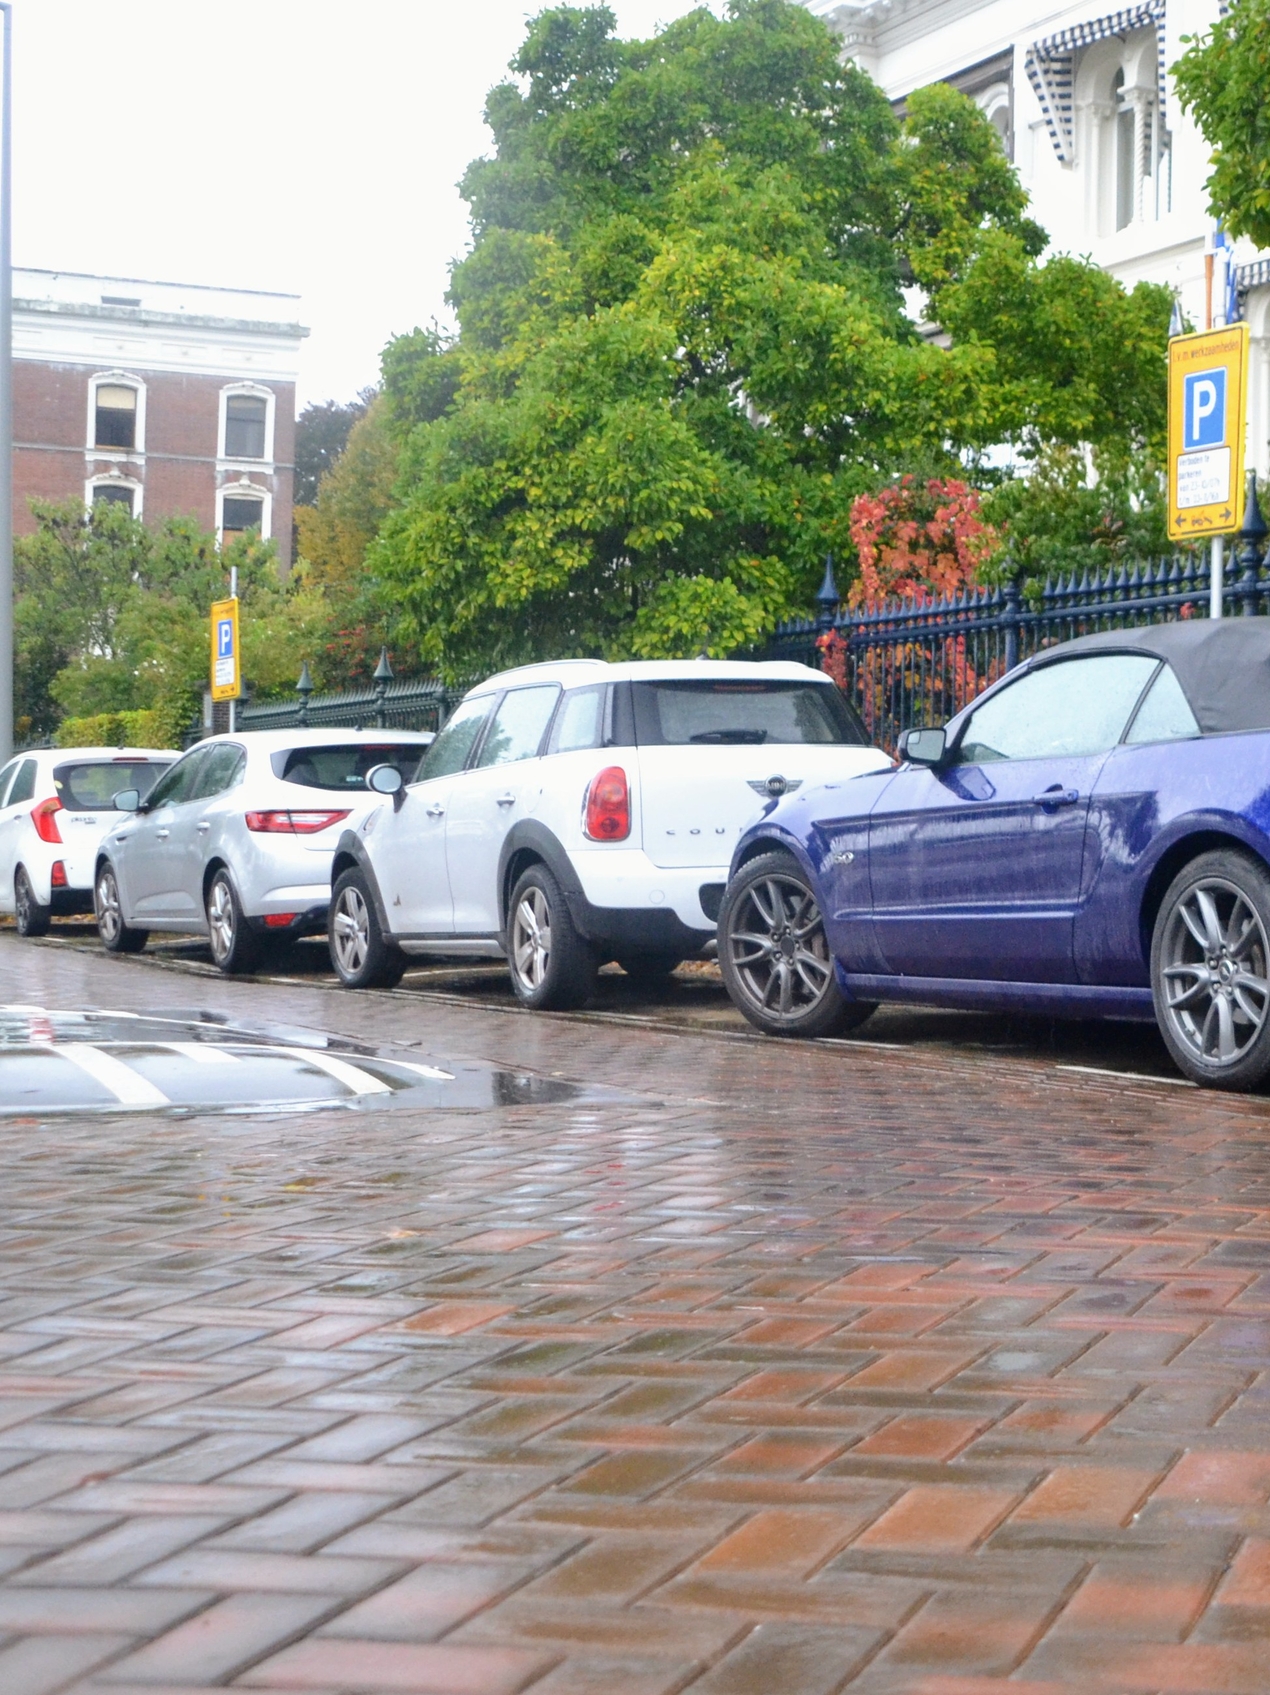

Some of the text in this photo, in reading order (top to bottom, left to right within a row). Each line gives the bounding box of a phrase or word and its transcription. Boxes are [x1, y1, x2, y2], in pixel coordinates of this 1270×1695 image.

[1191, 340, 1240, 358] werkzaamheden
[1192, 379, 1217, 440] P
[221, 623, 231, 654] P
